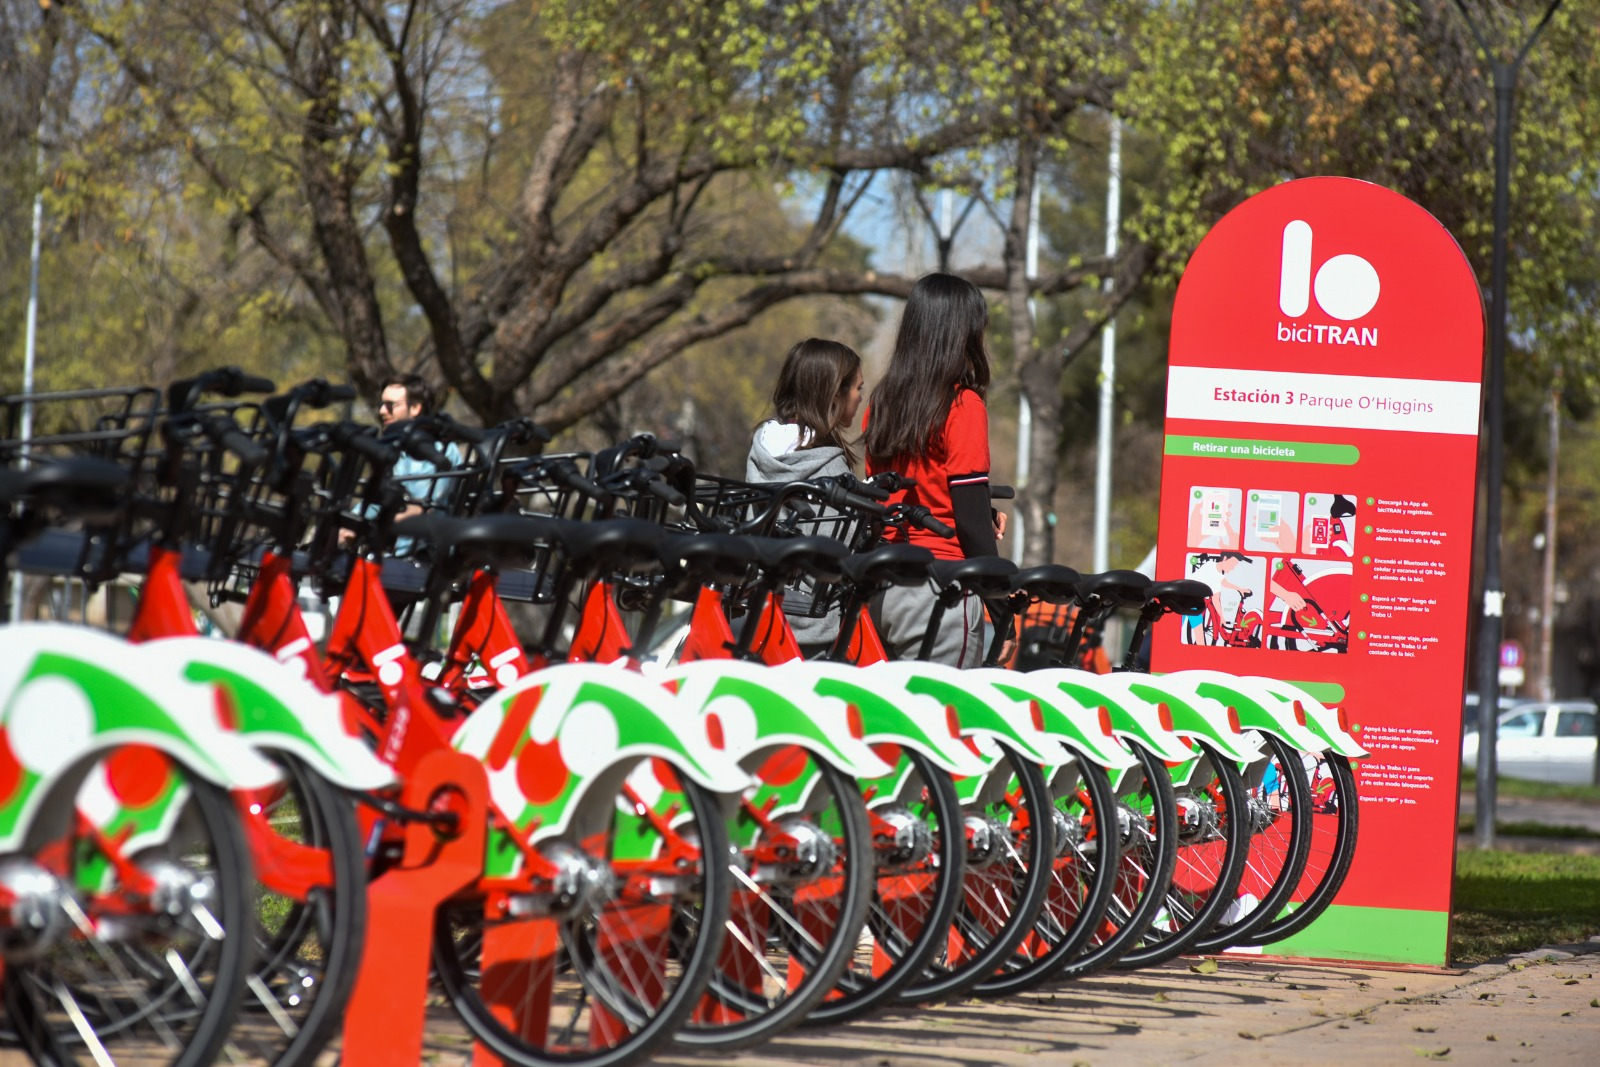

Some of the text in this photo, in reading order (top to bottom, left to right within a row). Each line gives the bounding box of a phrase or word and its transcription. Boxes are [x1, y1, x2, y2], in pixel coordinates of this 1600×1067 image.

[1277, 322, 1378, 346] biciTRAN
[1214, 388, 1433, 415] Estación 3 Parque O'Higgins
[1193, 442, 1295, 456] Retirar una bicicleta
